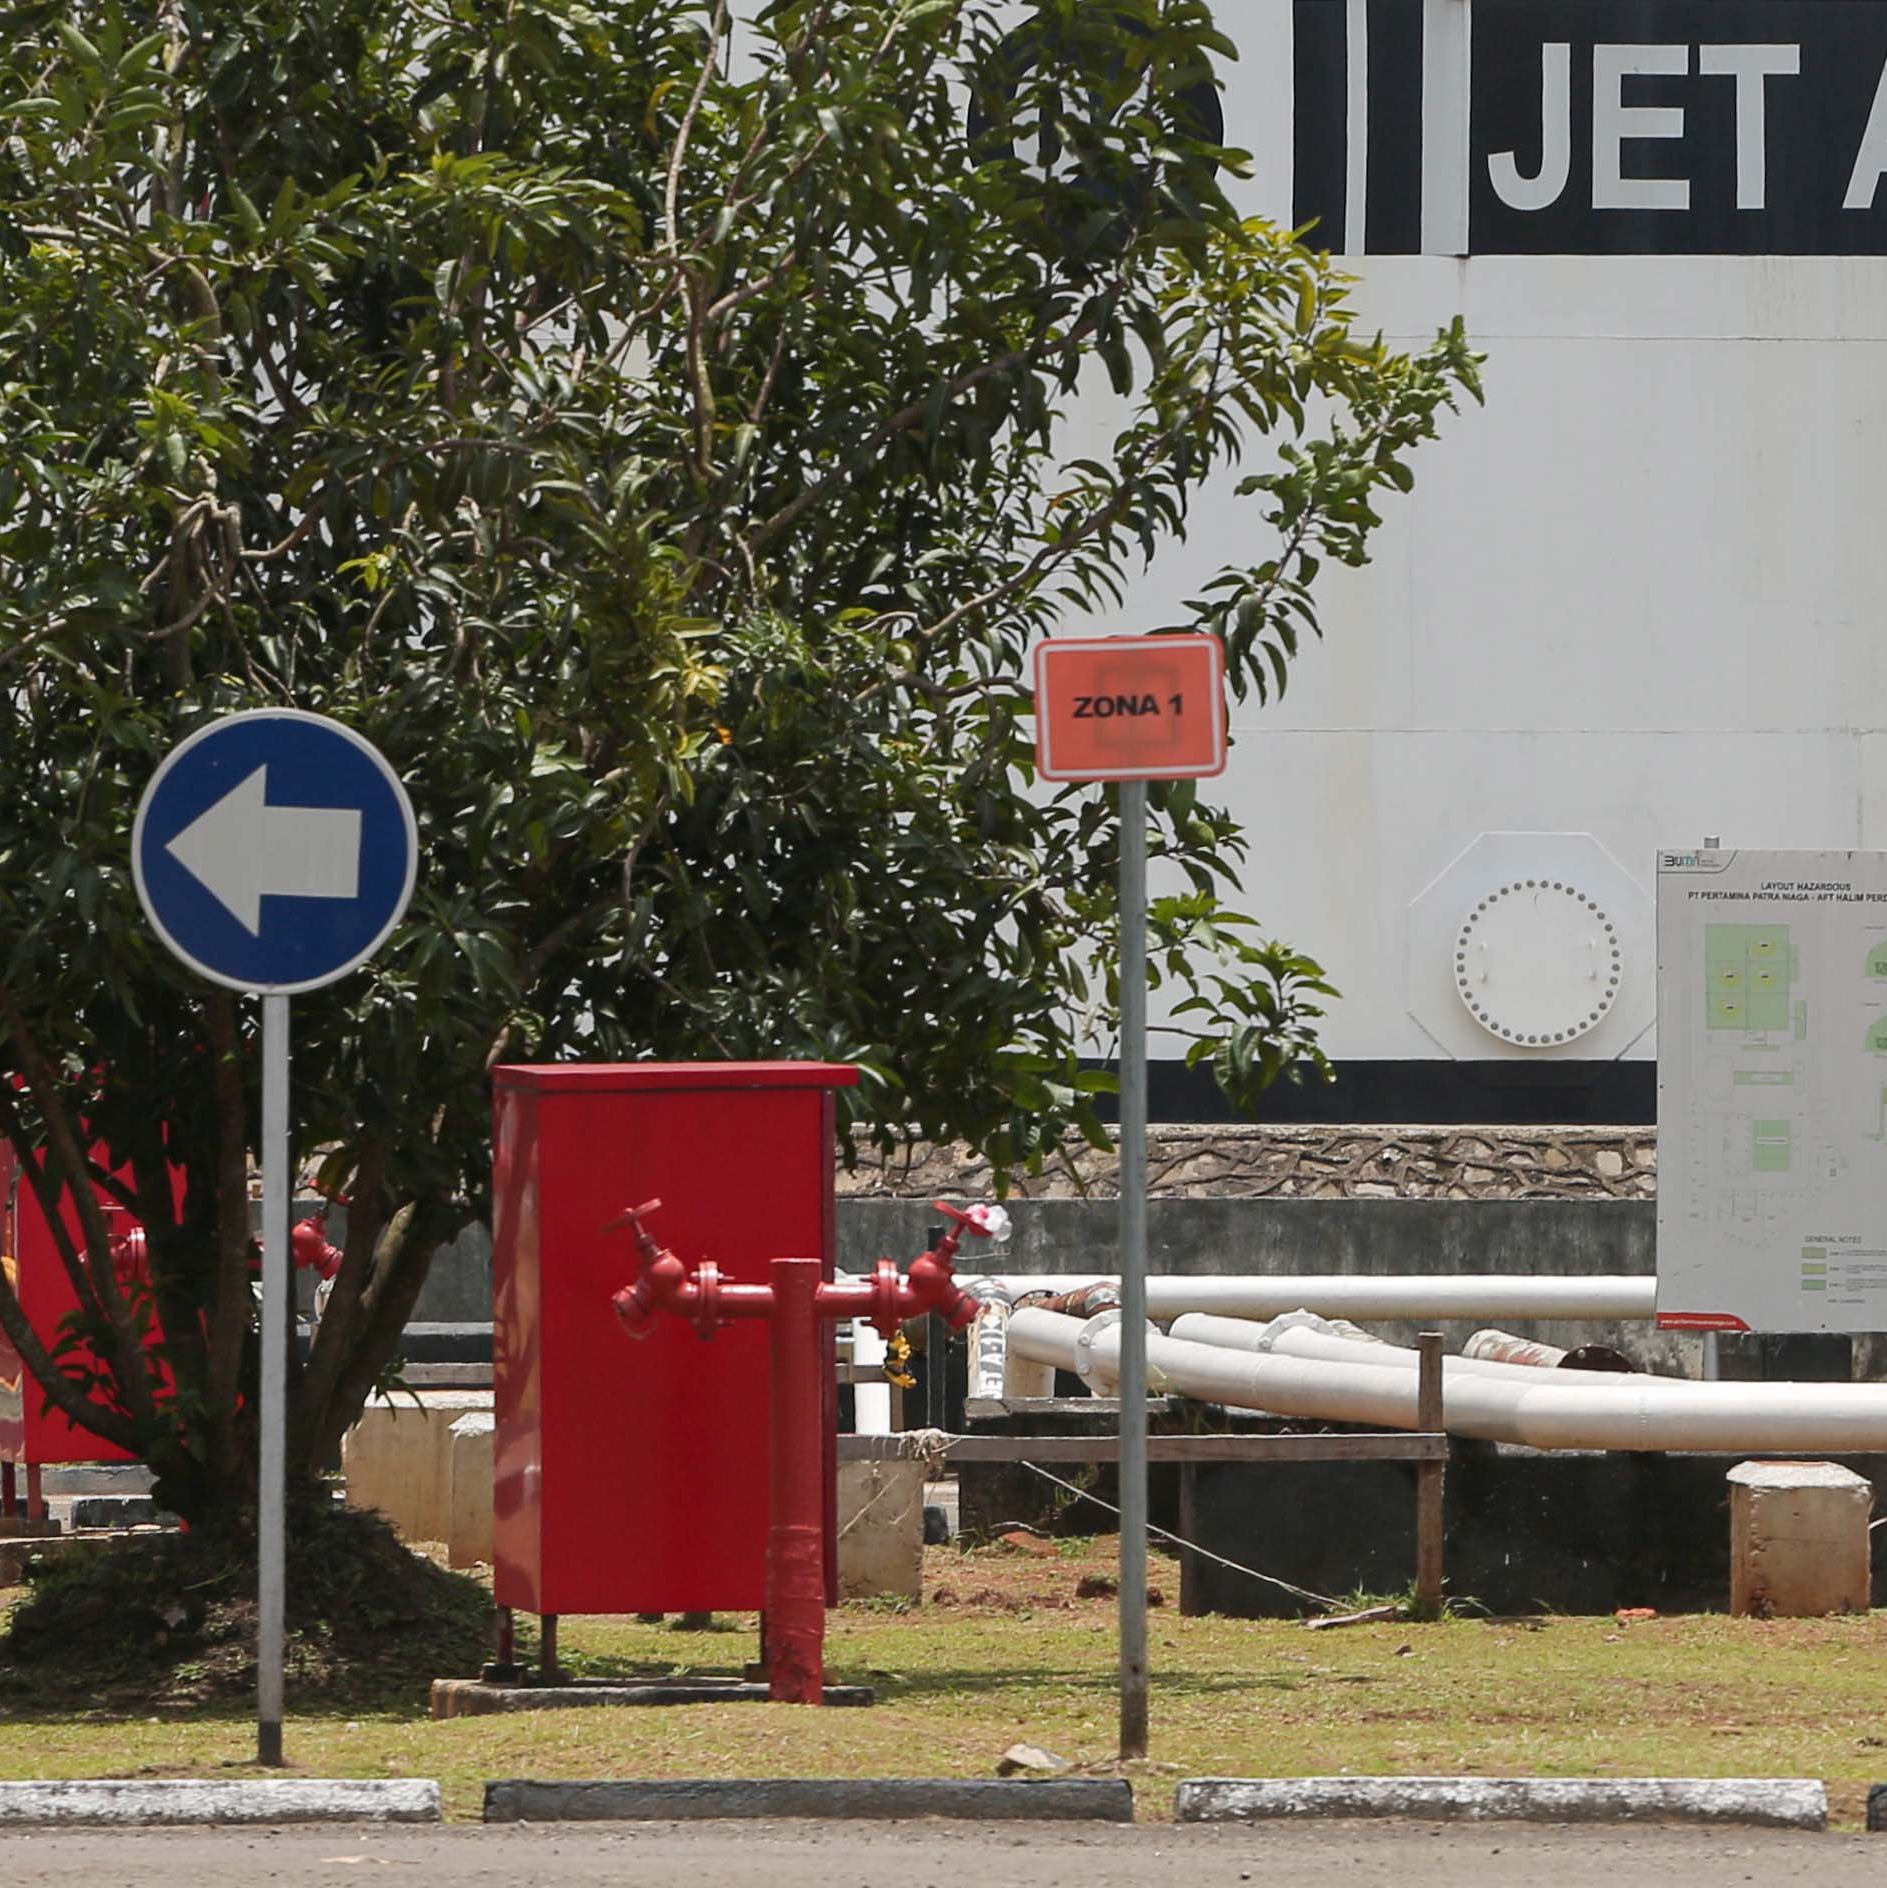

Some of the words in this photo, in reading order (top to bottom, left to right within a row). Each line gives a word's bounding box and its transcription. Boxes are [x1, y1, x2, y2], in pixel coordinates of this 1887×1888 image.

[1488, 42, 1800, 213] JET
[1072, 694, 1160, 719] ZONA
[1168, 695, 1183, 716] 1
[1688, 892, 1699, 900] PT
[1701, 891, 1750, 901] PERTAMINA
[1752, 892, 1780, 901] PATRA
[1782, 893, 1810, 902] NIAGA
[1817, 893, 1835, 901] AFT
[1836, 894, 1864, 902] HALIM
[1761, 882, 1794, 891] LAYOUT
[1797, 883, 1851, 891] HAZARDOUS
[979, 1371, 1003, 1399] JET
